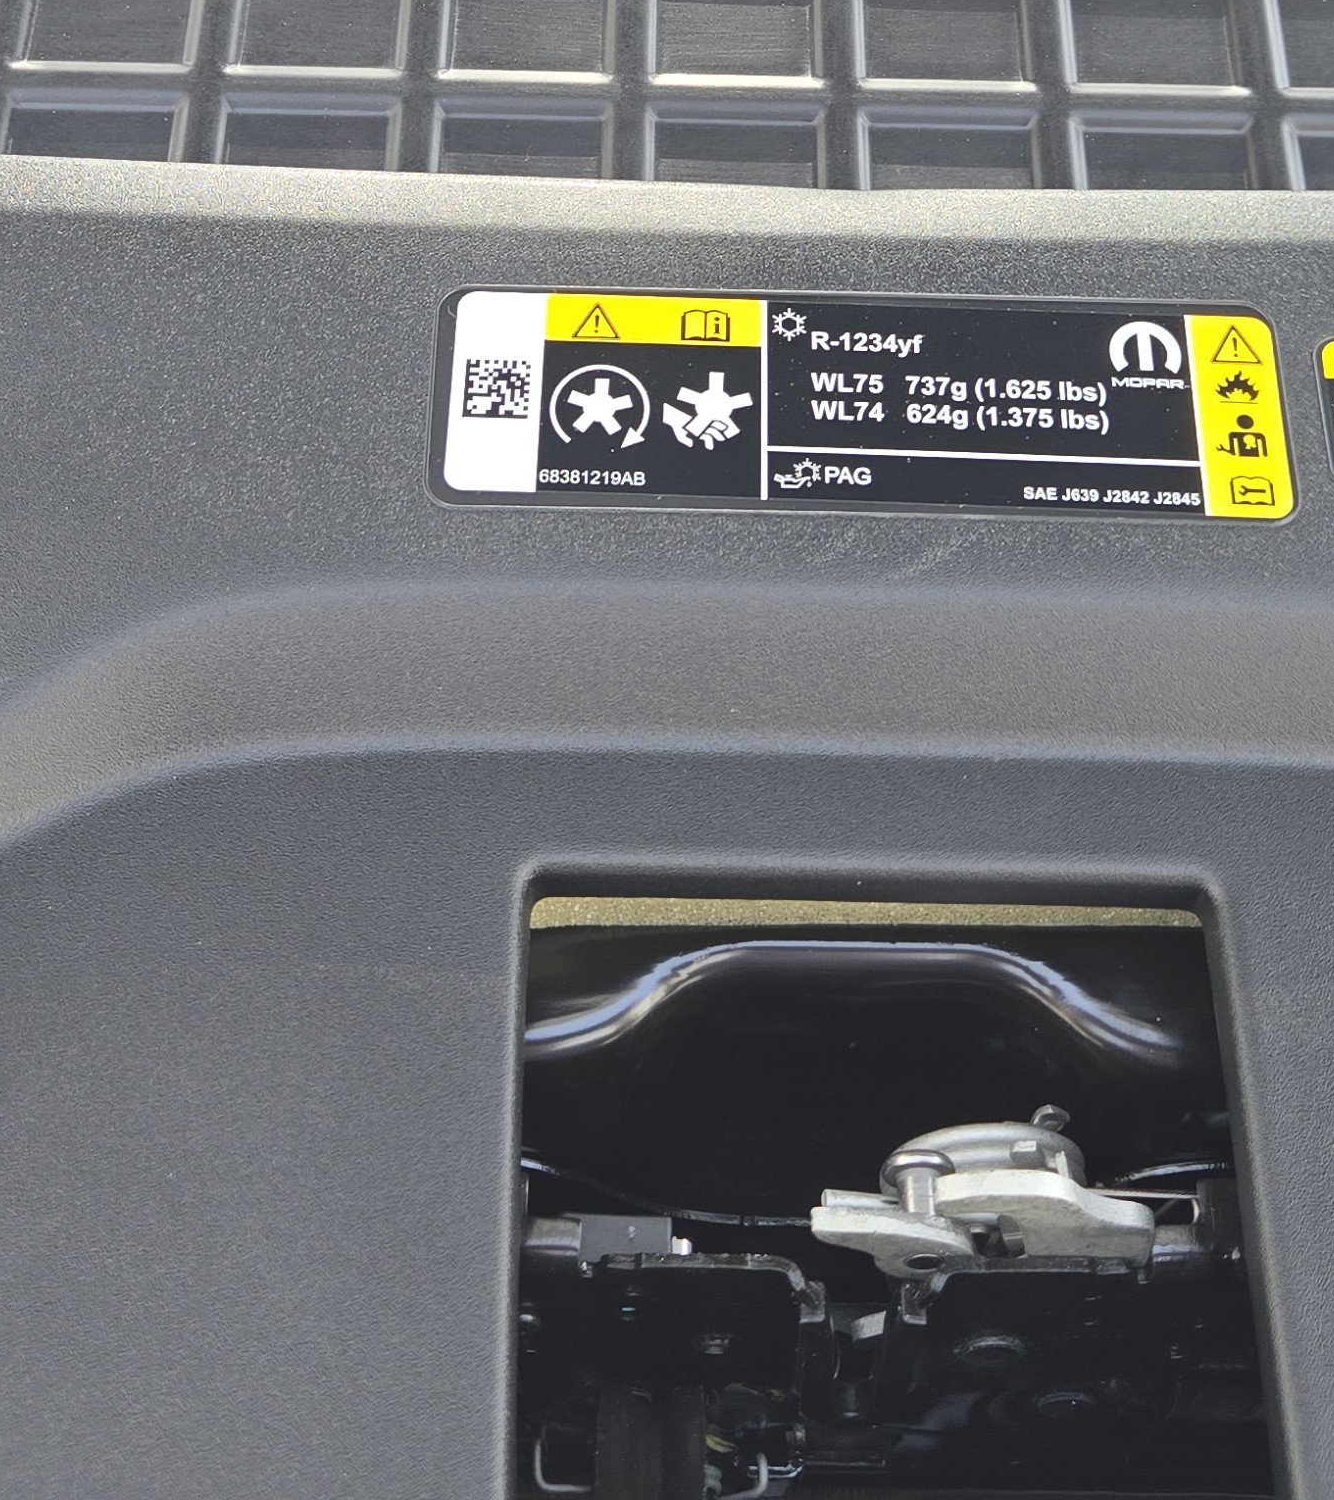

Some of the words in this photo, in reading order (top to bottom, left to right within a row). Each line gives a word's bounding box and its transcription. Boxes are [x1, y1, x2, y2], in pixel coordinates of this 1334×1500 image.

[810, 330, 924, 358] R-1234yf
[810, 372, 885, 394] WL75
[904, 375, 968, 402] 737g
[974, 377, 1052, 403] (1.625
[1058, 381, 1108, 407] lbs)
[1110, 376, 1187, 390] MOPAR
[810, 399, 886, 422] WL74
[906, 403, 969, 430] 624g
[976, 405, 1054, 431] (1.375
[1060, 408, 1110, 435] lbs)
[538, 468, 647, 487] 68381219AB
[823, 466, 872, 486] PAG
[1022, 485, 1058, 501] SAE
[1061, 487, 1100, 503] J639
[1103, 488, 1150, 505] J2842
[1153, 490, 1202, 507] J2845
